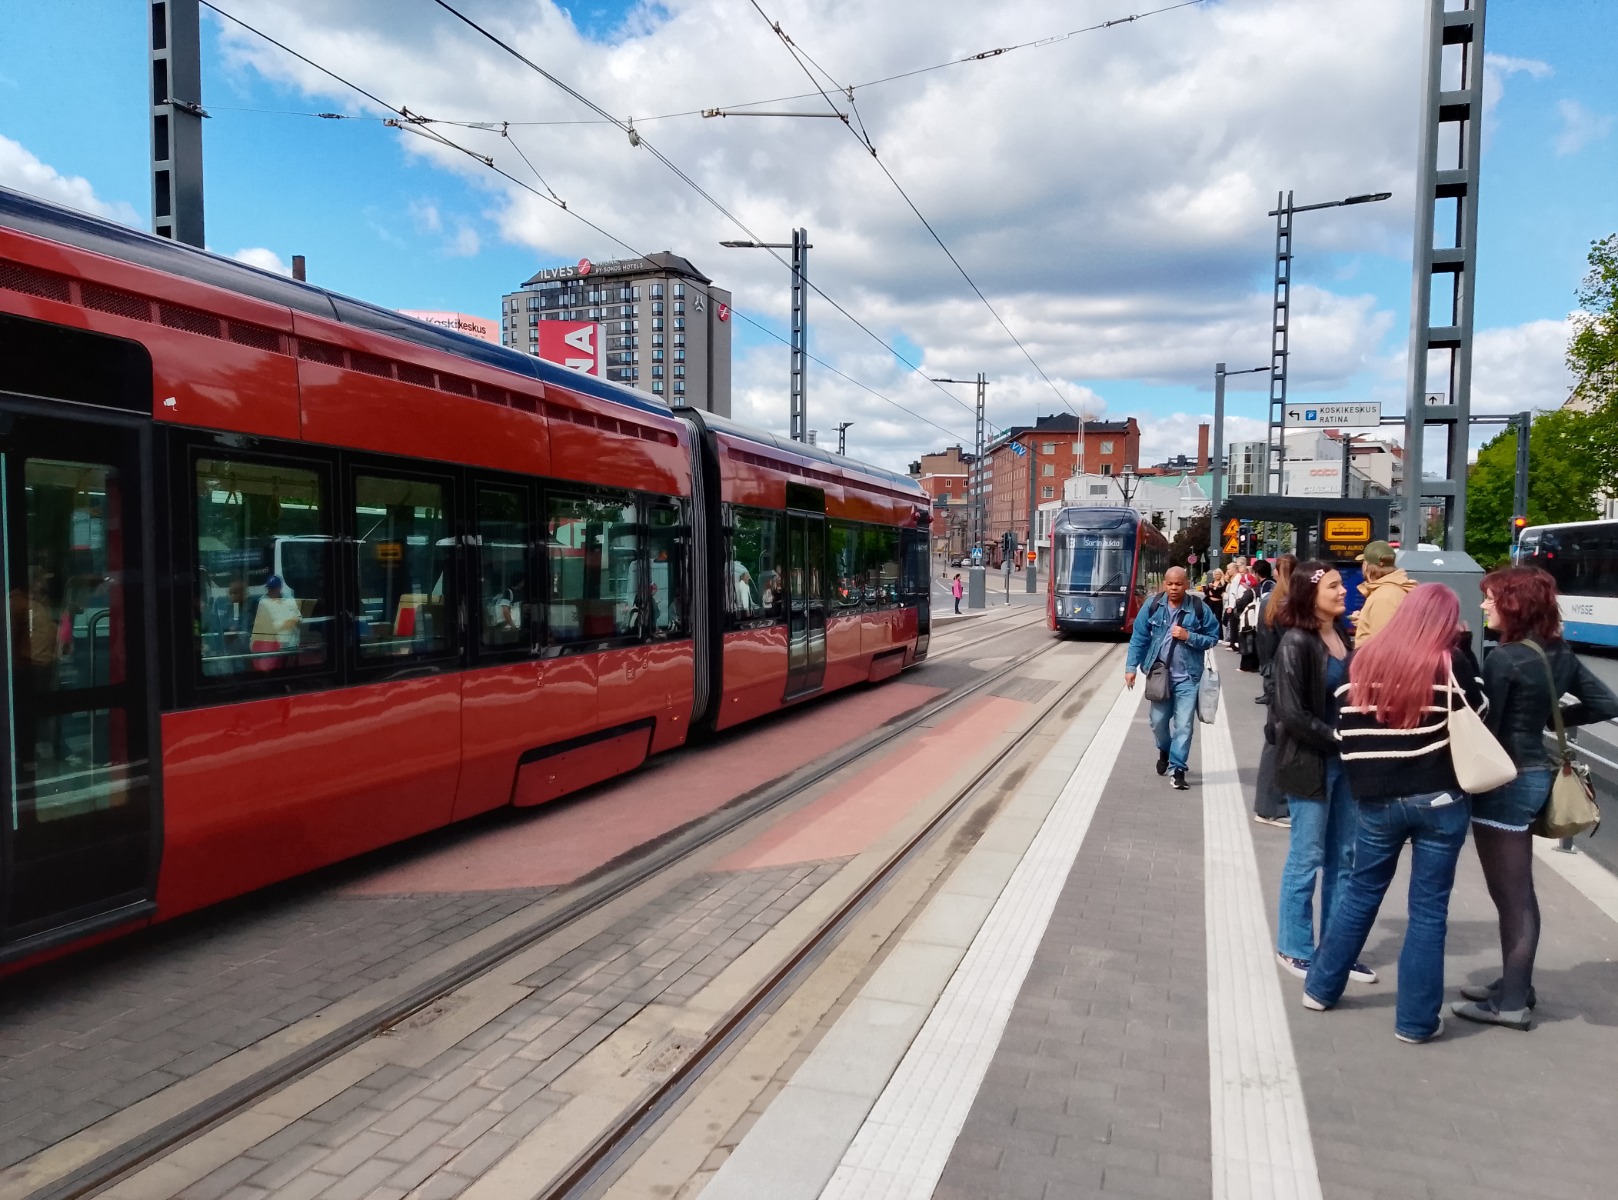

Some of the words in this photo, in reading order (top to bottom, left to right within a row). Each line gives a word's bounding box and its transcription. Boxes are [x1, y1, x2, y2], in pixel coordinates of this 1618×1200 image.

[540, 265, 574, 279] ILVES
[1320, 406, 1377, 414] KOSKIKESKUS
[1572, 604, 1593, 615] NYSSE
